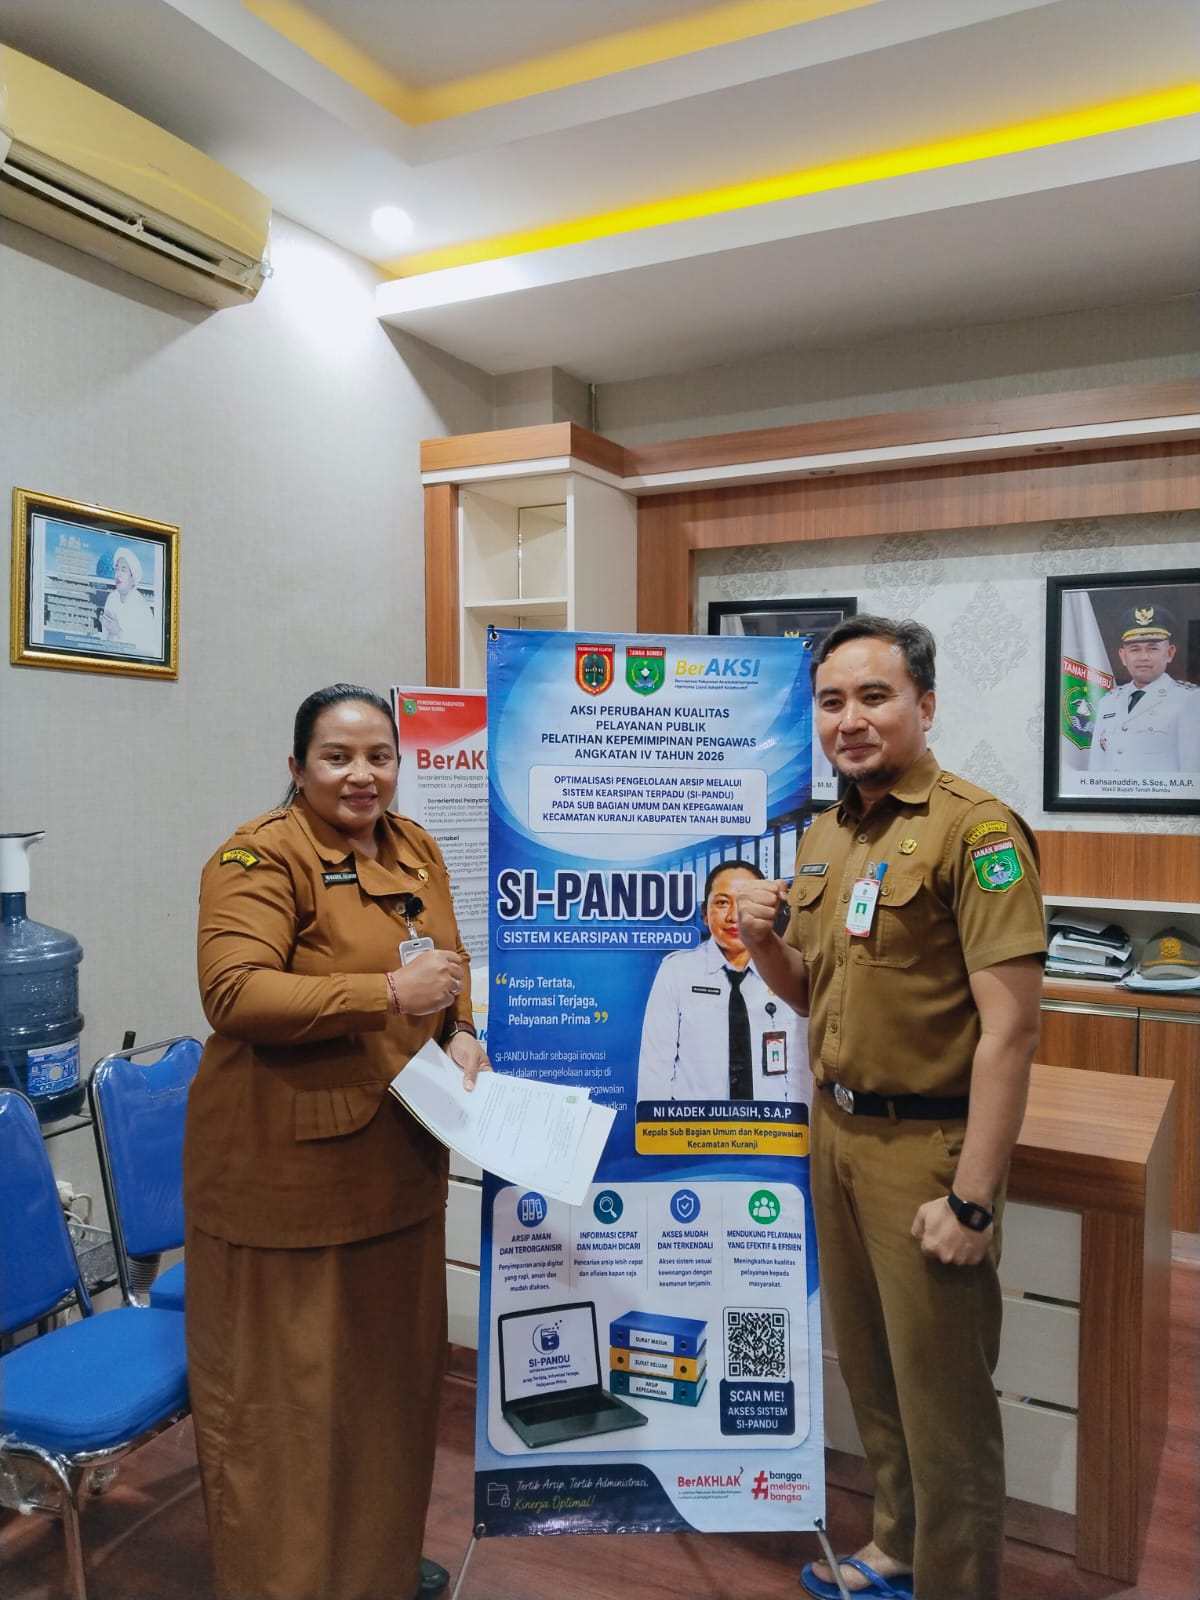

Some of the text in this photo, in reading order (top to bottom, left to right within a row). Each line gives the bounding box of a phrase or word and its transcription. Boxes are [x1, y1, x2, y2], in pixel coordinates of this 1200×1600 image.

[674, 658, 761, 677] BerAKSI
[1064, 660, 1087, 679] TANAH
[570, 705, 730, 719] AKSI PERUBAHAN KUALITAS
[596, 720, 706, 732] PELAYANAN PUBLIK
[541, 733, 757, 747] PELATIHAN KEPEMIMIPINAN PENGAWAS
[574, 748, 725, 761] ANGKATAN IV TAHUN 2026
[554, 775, 742, 787] OPTIMALISASI PENGELOLAAN ARSIP MELALUI
[1089, 778, 1141, 787] Bahsanuddin,
[1169, 779, 1195, 787] M.A.P.
[562, 788, 734, 800] SISTEM KEARSIPAN TERPADU (SI-PANDU)
[552, 800, 744, 812] PADA SUB BAGIAN UMUM DAN KEPEGAWAIAN
[542, 812, 752, 824] KECAMATAN KURANJI KABUPATEN TANAH BUMBU
[497, 868, 696, 922] SI-PANDU
[503, 931, 551, 944] SISTEM
[554, 931, 629, 944] KEARSIPAN
[631, 931, 692, 944] TERPADU
[508, 976, 576, 990] Arsip Tertata,
[508, 994, 598, 1008] Informasi Terjaga,
[508, 1013, 591, 1027] Pelayanan Prima
[495, 1050, 606, 1063] SI-PANDU hadir sebagai inovasi
[515, 1067, 538, 1078] dalam
[538, 1067, 584, 1079] pengelolaan
[584, 1067, 603, 1077] arsip
[604, 1066, 612, 1077] di
[653, 1107, 792, 1119] NI KADEK JULIASIH, S.A.P
[642, 1128, 803, 1139] Kepala Sub Bagian Umum dan Kepegawaian
[687, 1140, 759, 1150] Kecamatan Kuranji
[511, 1232, 552, 1242] ARSIP AMAN
[579, 1231, 638, 1239] INFORMASI CEPAT
[661, 1230, 709, 1238] AKSES MUDAH
[727, 1230, 802, 1240] MENDUKUNG PELAYANAN
[499, 1243, 562, 1256] DAN TERORGANISIR
[576, 1242, 641, 1251] DAN MUDAH DICARI
[657, 1241, 714, 1250] DAN TERKENDALI
[727, 1241, 802, 1252] YANG EFEKTIF & EFISIEN
[498, 1259, 564, 1271] Penyimpanan arsip digital
[600, 1259, 614, 1267] arsip
[628, 1259, 644, 1267] cepat
[675, 1257, 694, 1265] sistem
[733, 1257, 796, 1266] Meningkatkan kualitas
[504, 1274, 518, 1282] yang
[608, 1270, 625, 1278] kapan
[658, 1269, 713, 1277] kewenangan dengan
[740, 1269, 790, 1277] pelayanan kepada
[510, 1283, 529, 1291] mudah
[635, 1336, 651, 1344] SURAT
[528, 1354, 570, 1368] SI-PANDU
[635, 1359, 668, 1369] SURAT KELUAR
[730, 1390, 785, 1403] SCAN ME!
[728, 1406, 788, 1416] AKSES SISTEM
[736, 1419, 778, 1429] SI-PANDU
[677, 1475, 742, 1488] BerAKHLAK
[769, 1470, 802, 1482] bangga
[516, 1480, 541, 1492] Tertib
[569, 1477, 594, 1489] Tertib
[769, 1482, 811, 1493] melayani
[770, 1492, 802, 1503] bangsa
[513, 1497, 549, 1515] Kinerja
